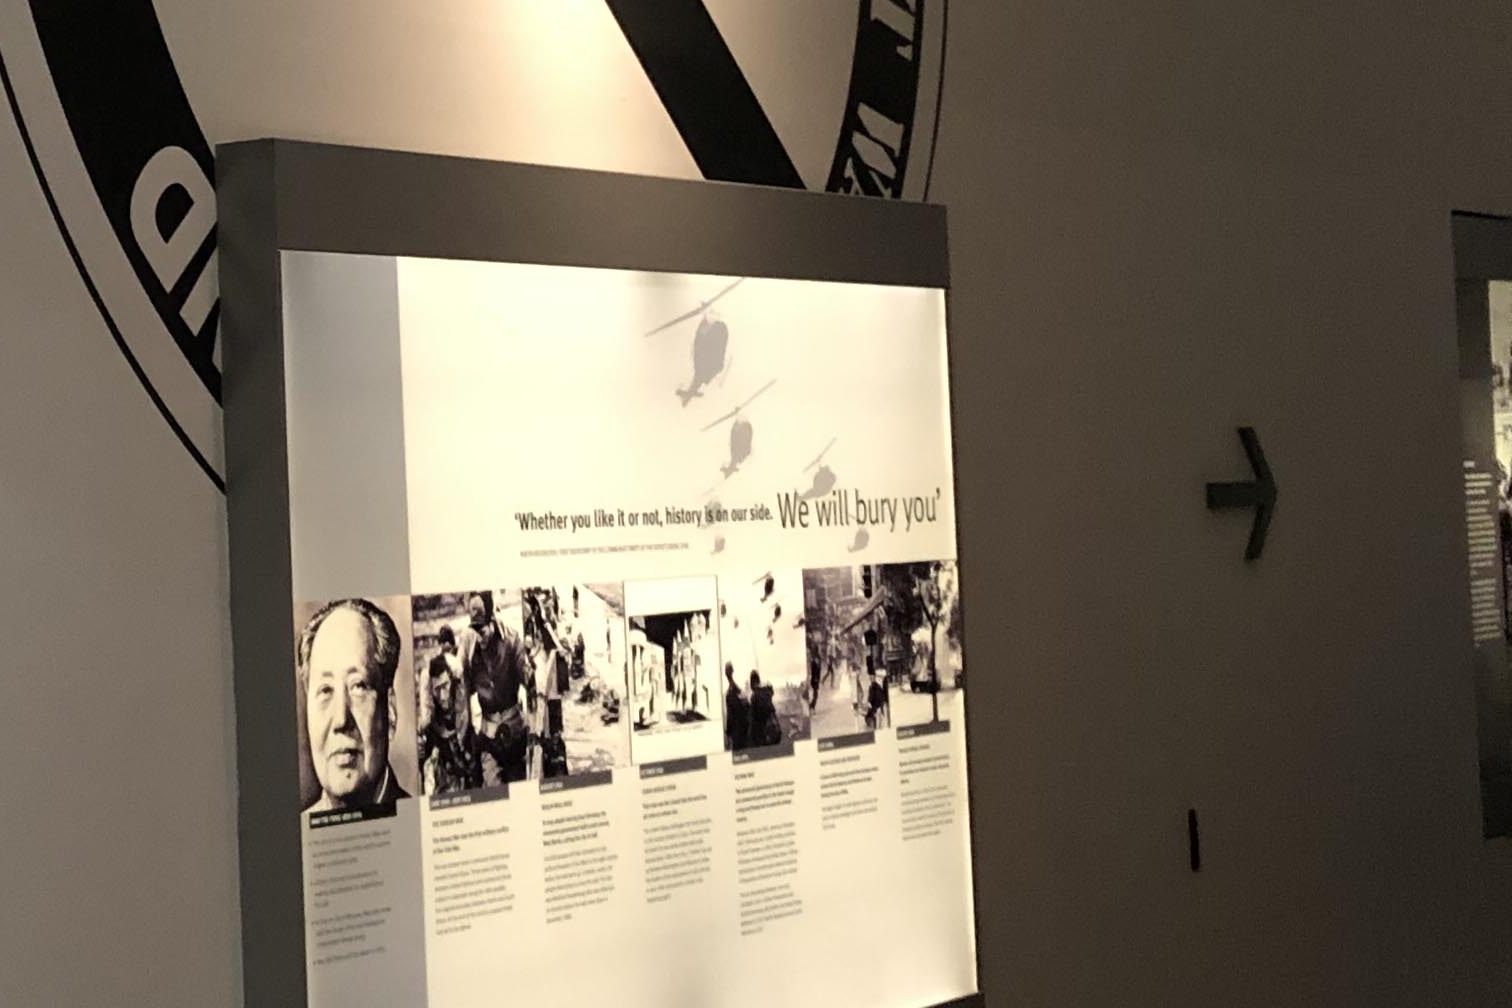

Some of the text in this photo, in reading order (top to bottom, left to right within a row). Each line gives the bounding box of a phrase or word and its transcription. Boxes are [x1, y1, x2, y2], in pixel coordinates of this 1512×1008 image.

[514, 487, 941, 533] 'Whether you like it or not, history is on our side. We will bury you'
